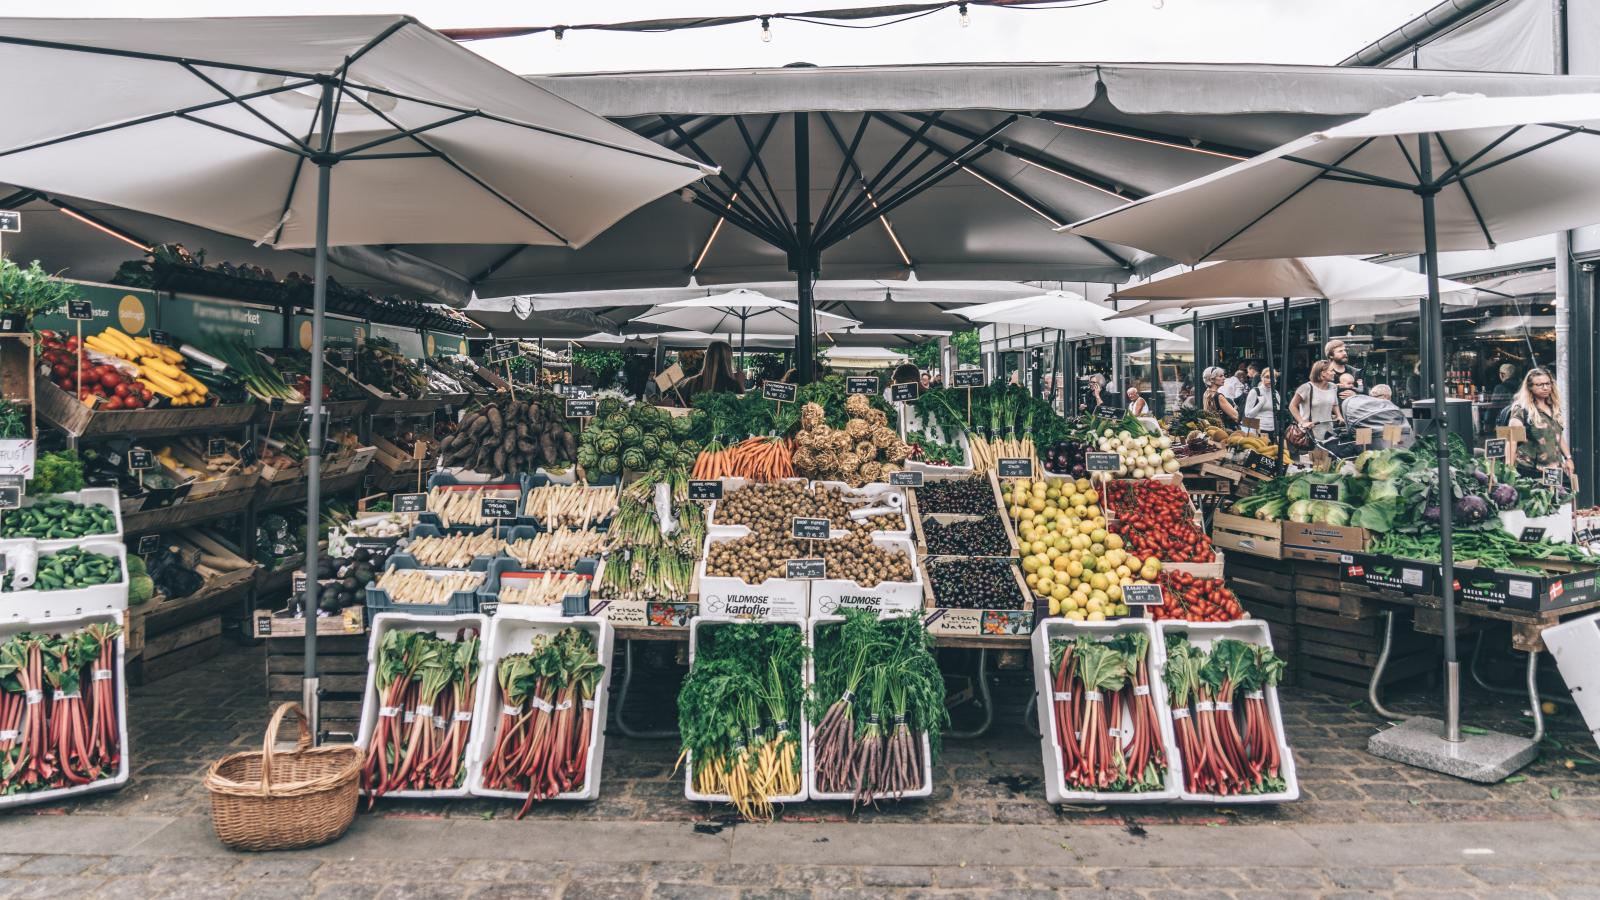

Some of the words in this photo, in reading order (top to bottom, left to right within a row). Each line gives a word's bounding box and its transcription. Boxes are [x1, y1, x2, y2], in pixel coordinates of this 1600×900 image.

[1463, 588, 1483, 596] GREEN
[727, 594, 768, 604] VILDMOSE
[840, 595, 881, 605] VILDMOSE
[725, 603, 770, 616] kartofler
[943, 613, 979, 621] Frisch
[942, 622, 977, 630] Natur
